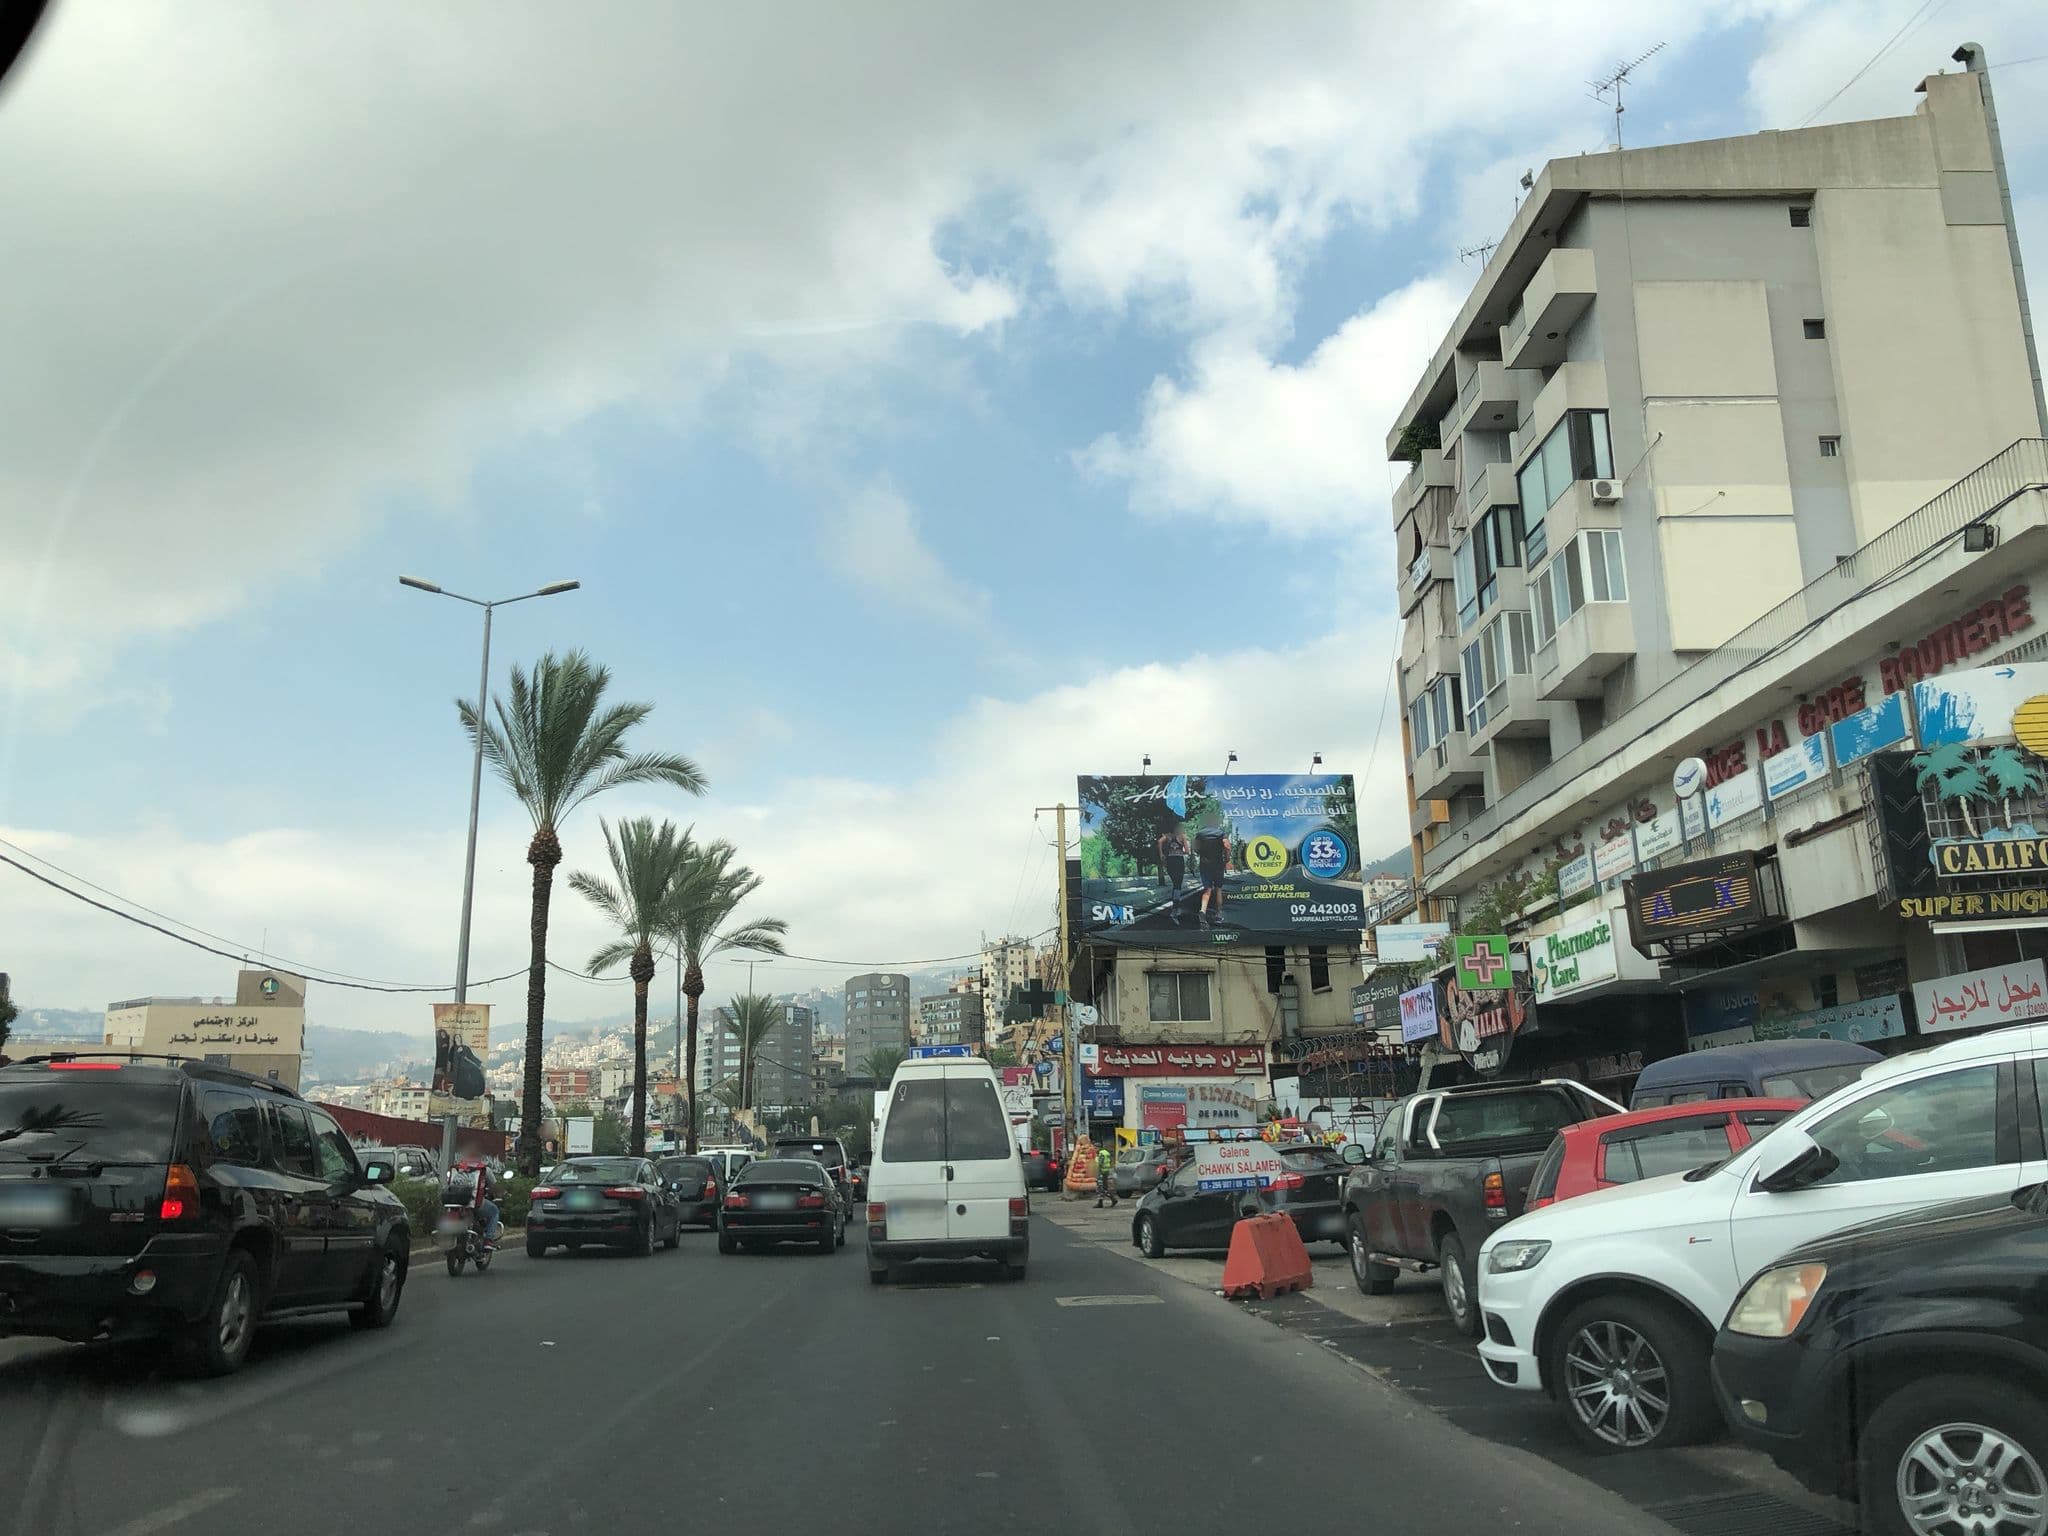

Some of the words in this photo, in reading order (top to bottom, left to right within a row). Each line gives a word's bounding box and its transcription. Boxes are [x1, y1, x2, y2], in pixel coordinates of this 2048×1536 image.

[1255, 841, 1280, 860] 0%
[1309, 841, 1341, 859] 33%
[1277, 891, 1311, 899] FACILITIES
[1290, 904, 1306, 915] 09
[1309, 903, 1357, 914] 442003
[1900, 894, 1984, 918] SUPER
[1547, 921, 1611, 963] Pharmacie
[1550, 962, 1580, 988] Karel
[1997, 973, 2042, 1013] محل
[1103, 1050, 1163, 1069] الحديثة
[1199, 1110, 1210, 1118] DE
[1213, 1109, 1239, 1118] PARIS
[1198, 1163, 1234, 1175] CHAWKI
[1237, 1160, 1281, 1173] SALAMEH
